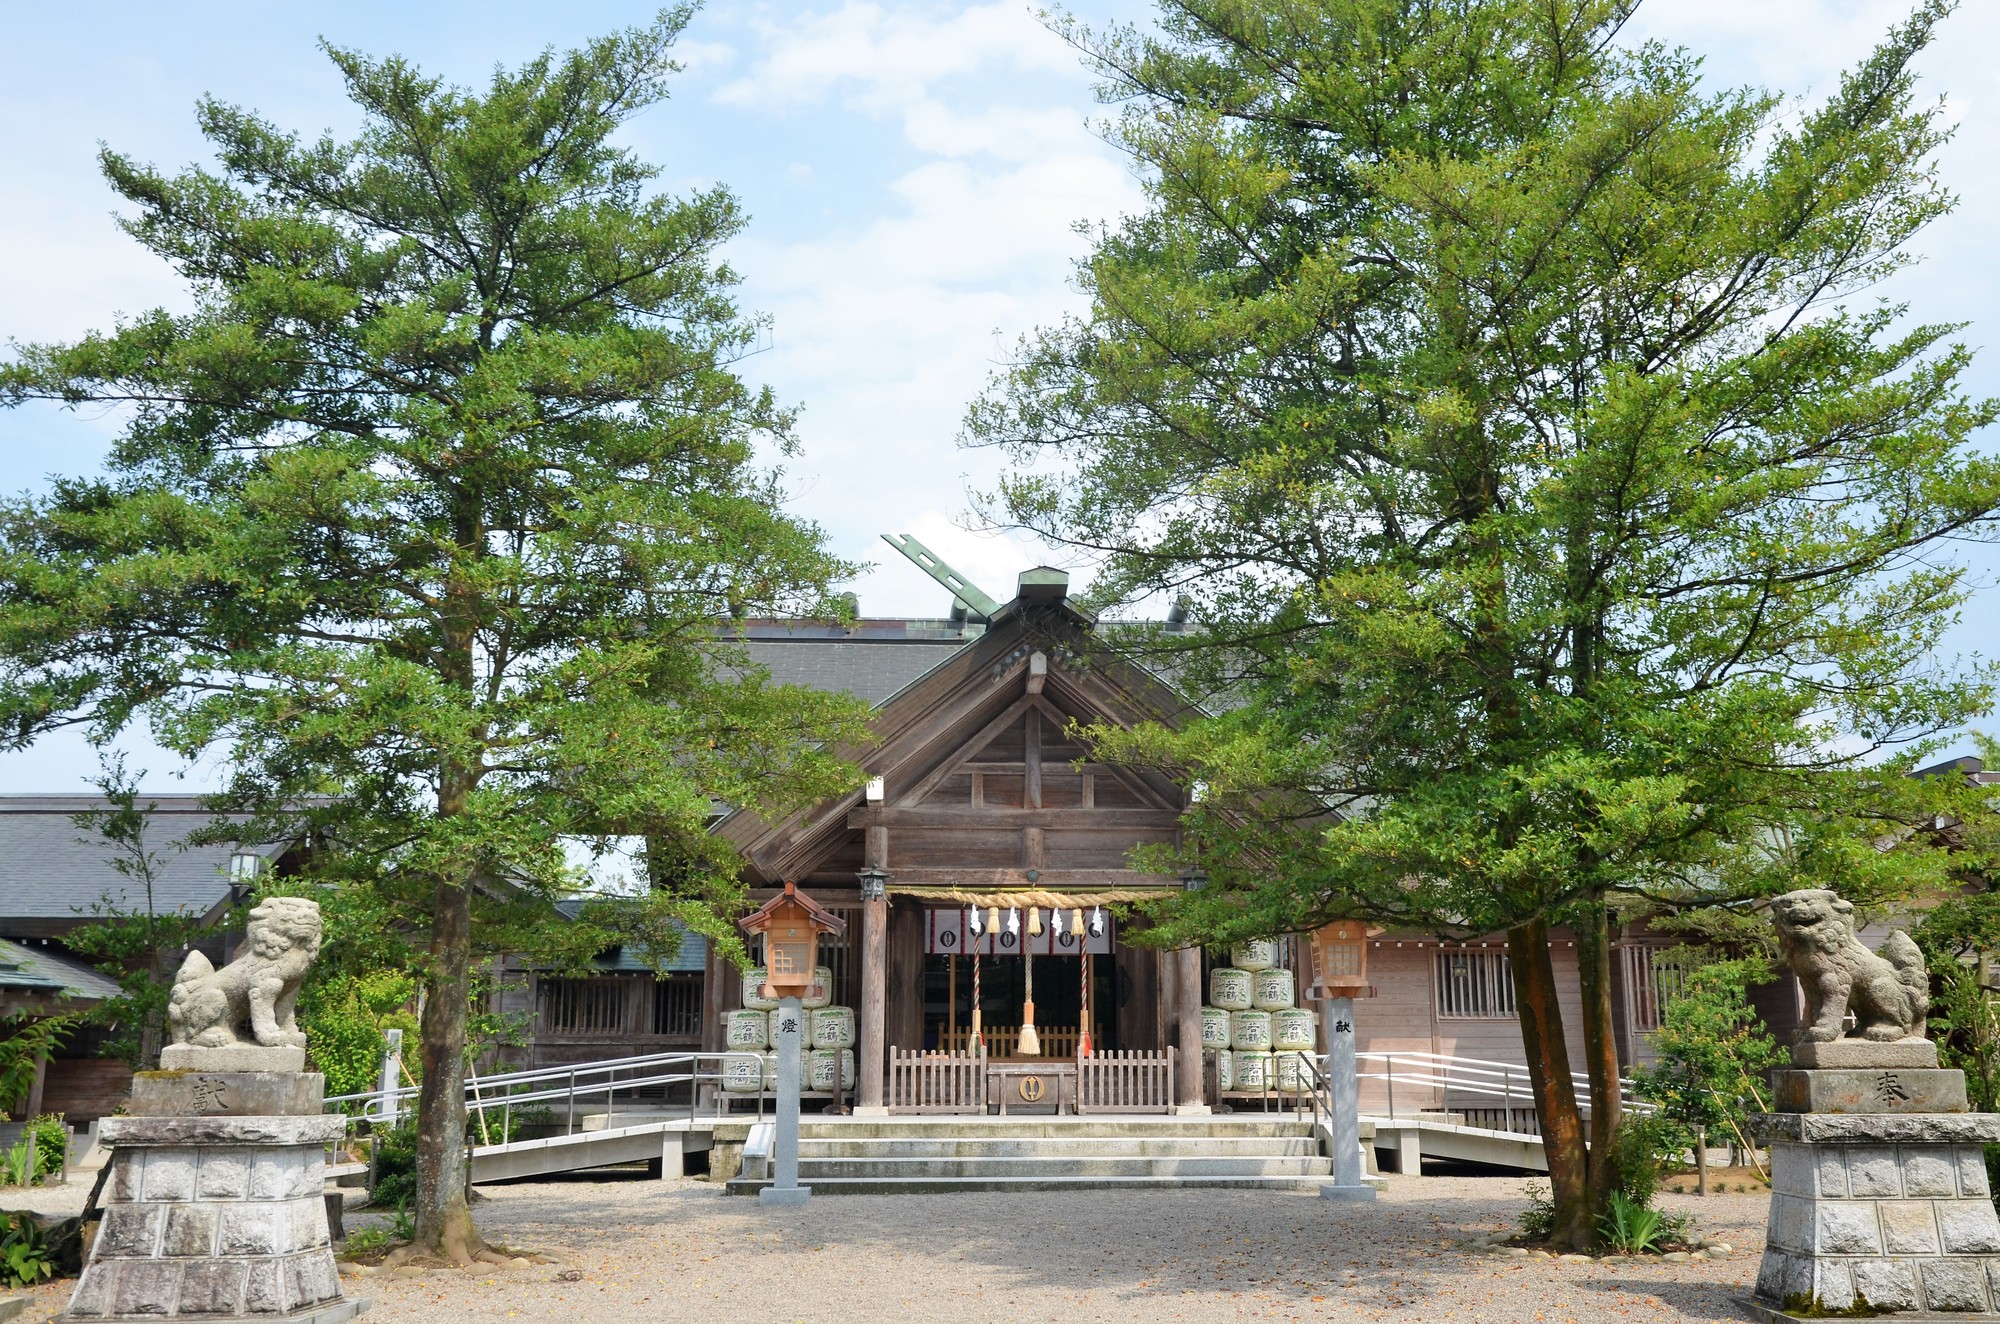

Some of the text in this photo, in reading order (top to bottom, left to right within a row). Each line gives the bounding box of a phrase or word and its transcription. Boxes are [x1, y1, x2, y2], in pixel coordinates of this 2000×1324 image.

[1224, 980, 1238, 1001] 若鶴
[1266, 980, 1280, 1001] 若鶴
[742, 1021, 755, 1043] 若鶴
[781, 1018, 798, 1033] 燈
[825, 1020, 839, 1042] 若鶴
[1203, 1019, 1217, 1040] 若鶴
[1246, 1022, 1260, 1043] 若鶴
[1288, 1020, 1302, 1042] 若鶴
[1335, 1020, 1351, 1033] 献
[1248, 1063, 1262, 1085] 若鶴
[1874, 1071, 1910, 1108] 奉
